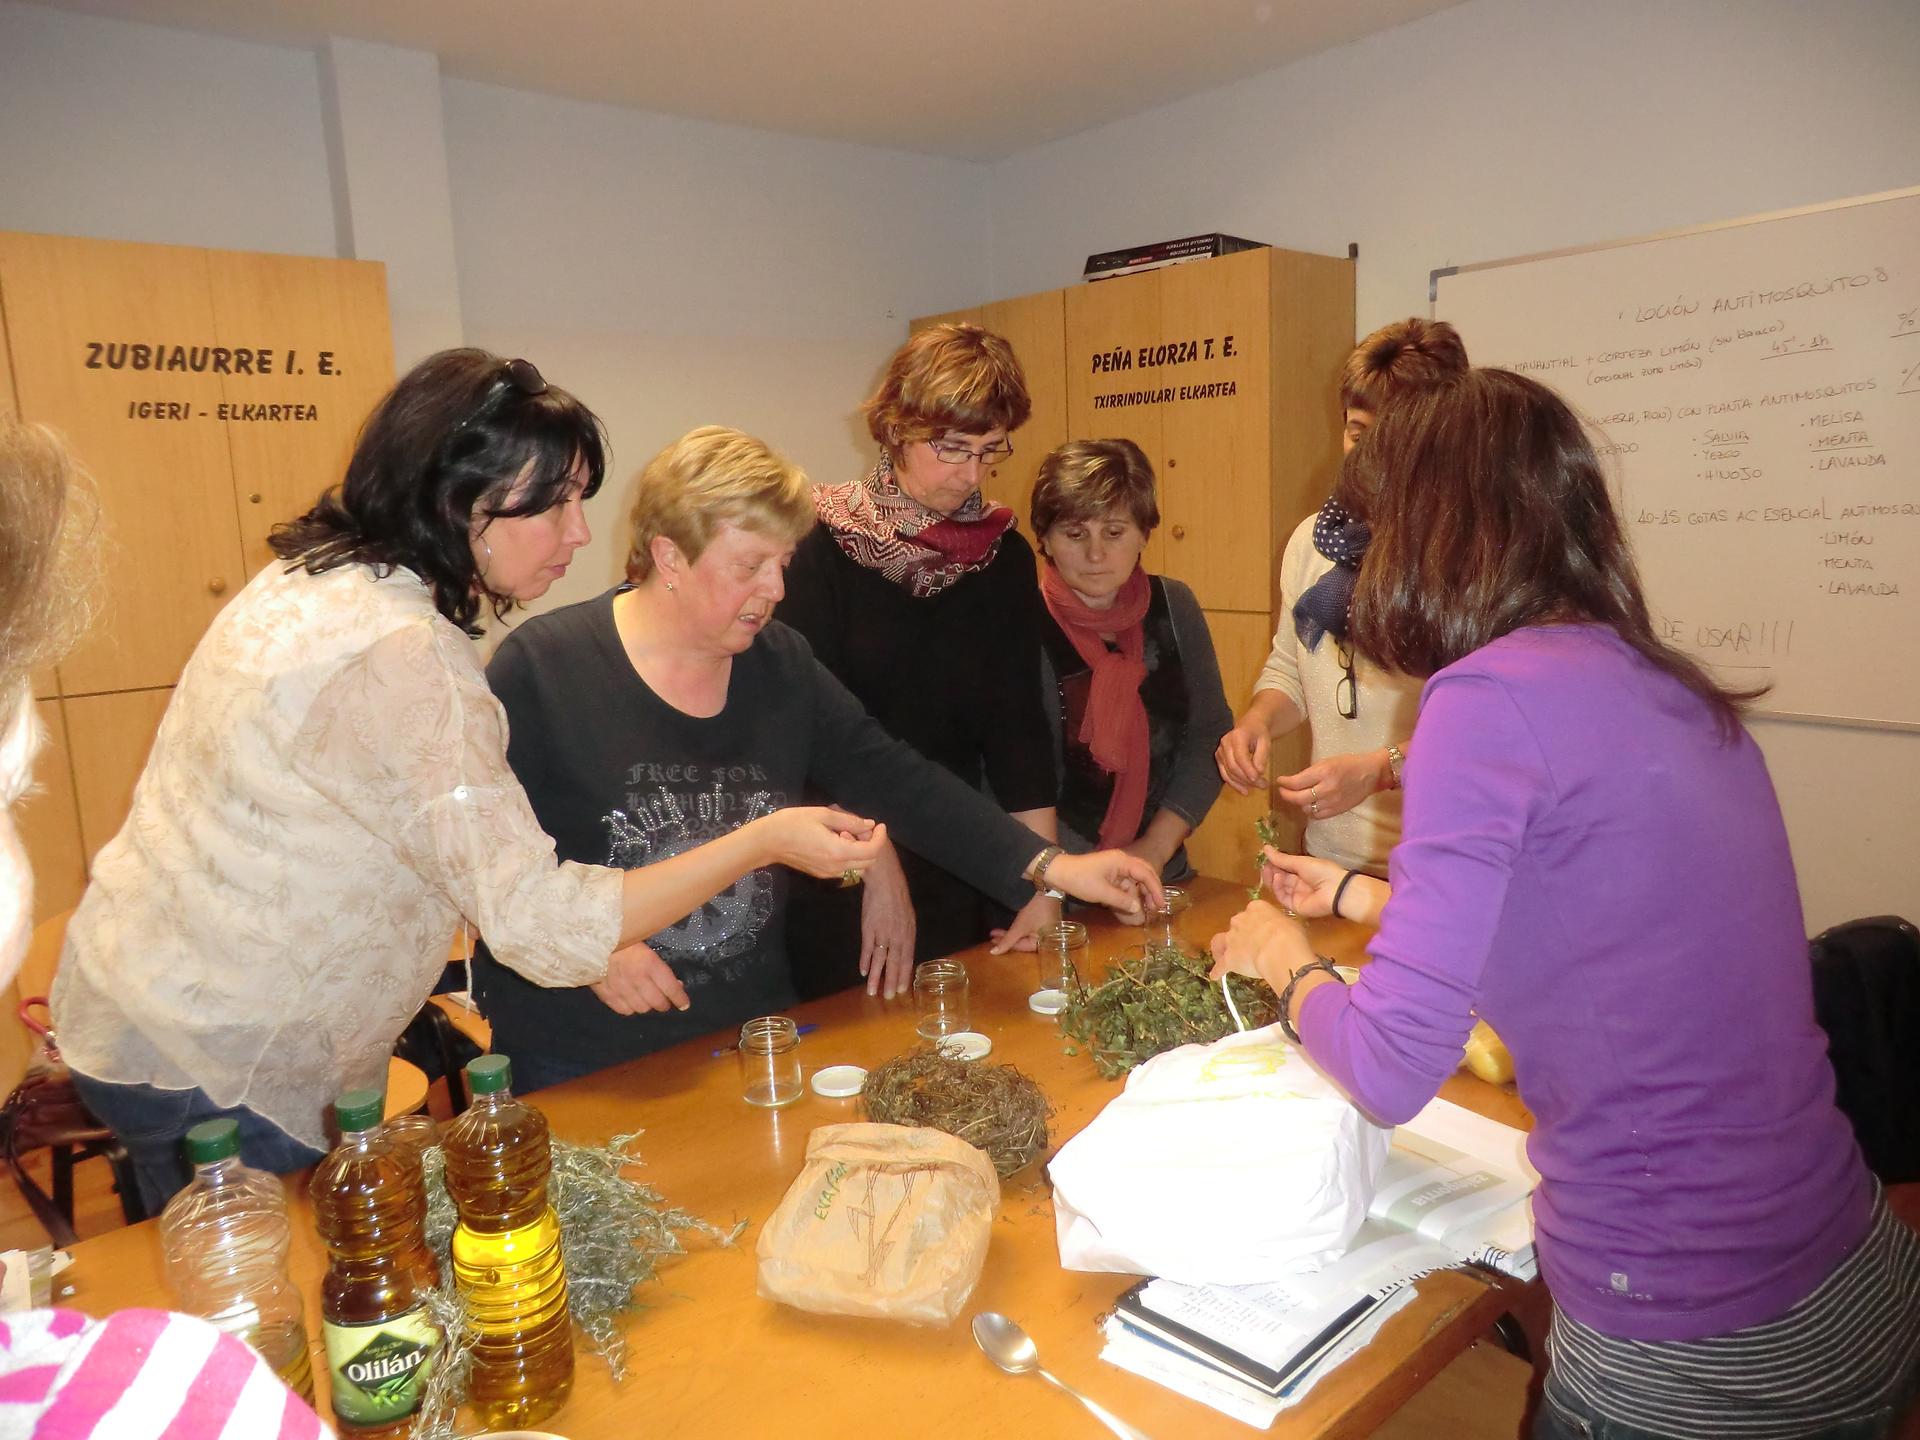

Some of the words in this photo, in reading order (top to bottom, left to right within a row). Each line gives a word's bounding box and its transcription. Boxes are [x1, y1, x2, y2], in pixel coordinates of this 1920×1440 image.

[1634, 291, 1700, 323] LOCIÓN
[1091, 346, 1132, 374] PEÑA
[1138, 340, 1198, 369] ELORZA
[1203, 338, 1215, 361] T.
[1223, 335, 1238, 357] E.
[1659, 337, 1701, 357] LIMÓN
[85, 342, 274, 376] ZUBIAURRE
[285, 349, 304, 375] I.
[318, 351, 343, 376] E.
[1094, 386, 1176, 410] TXIRRINDULARI
[1179, 381, 1237, 401] ELKARTEA
[1760, 378, 1877, 408] ANTIMOSQUITOS
[128, 402, 190, 420] IGERI
[217, 403, 318, 422] ELKARTEA
[1809, 410, 1865, 427] MELISA
[1818, 431, 1869, 447] MENTA
[1819, 453, 1887, 471] LAVANDA
[1823, 530, 1875, 546] LIMÓN
[1824, 557, 1874, 571] MENTA
[1828, 580, 1901, 596] LAVANDA
[625, 763, 700, 785] FREE
[711, 763, 768, 785] FOR
[347, 1350, 427, 1382] Olilán
